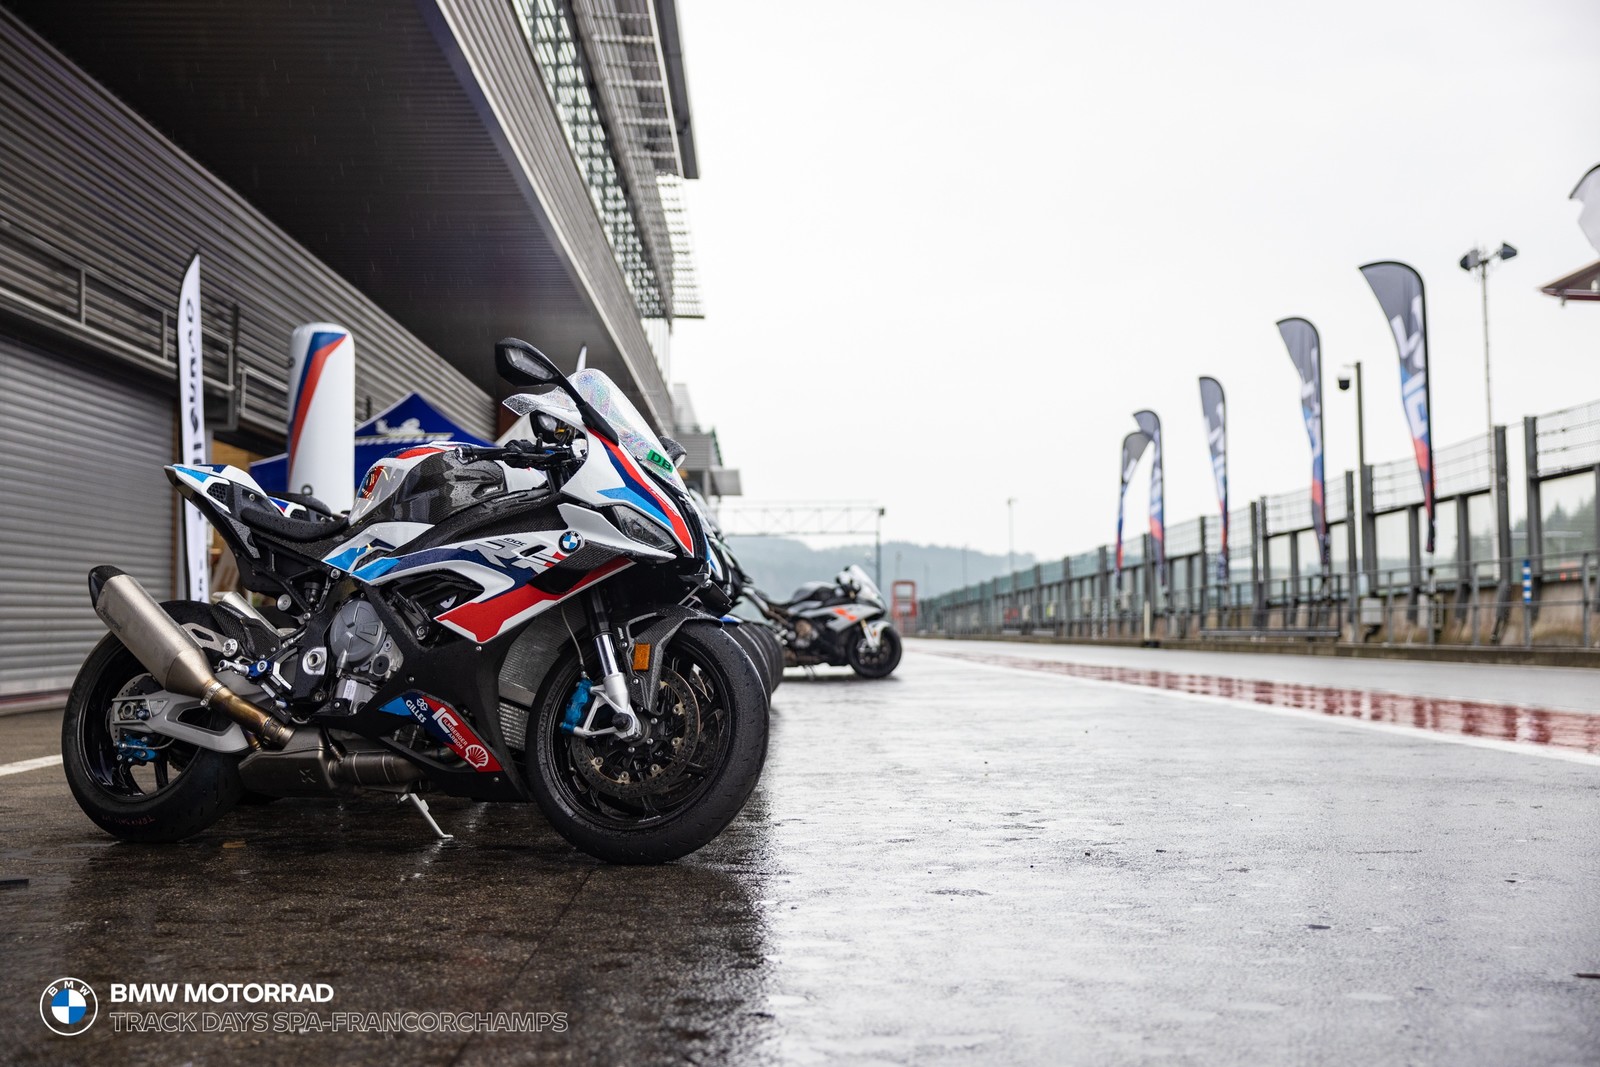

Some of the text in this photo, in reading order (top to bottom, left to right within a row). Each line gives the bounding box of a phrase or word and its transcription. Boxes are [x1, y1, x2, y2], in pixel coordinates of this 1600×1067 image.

[651, 452, 671, 470] DB
[405, 700, 426, 723] GILLES
[443, 718, 468, 745] ILMBERGER
